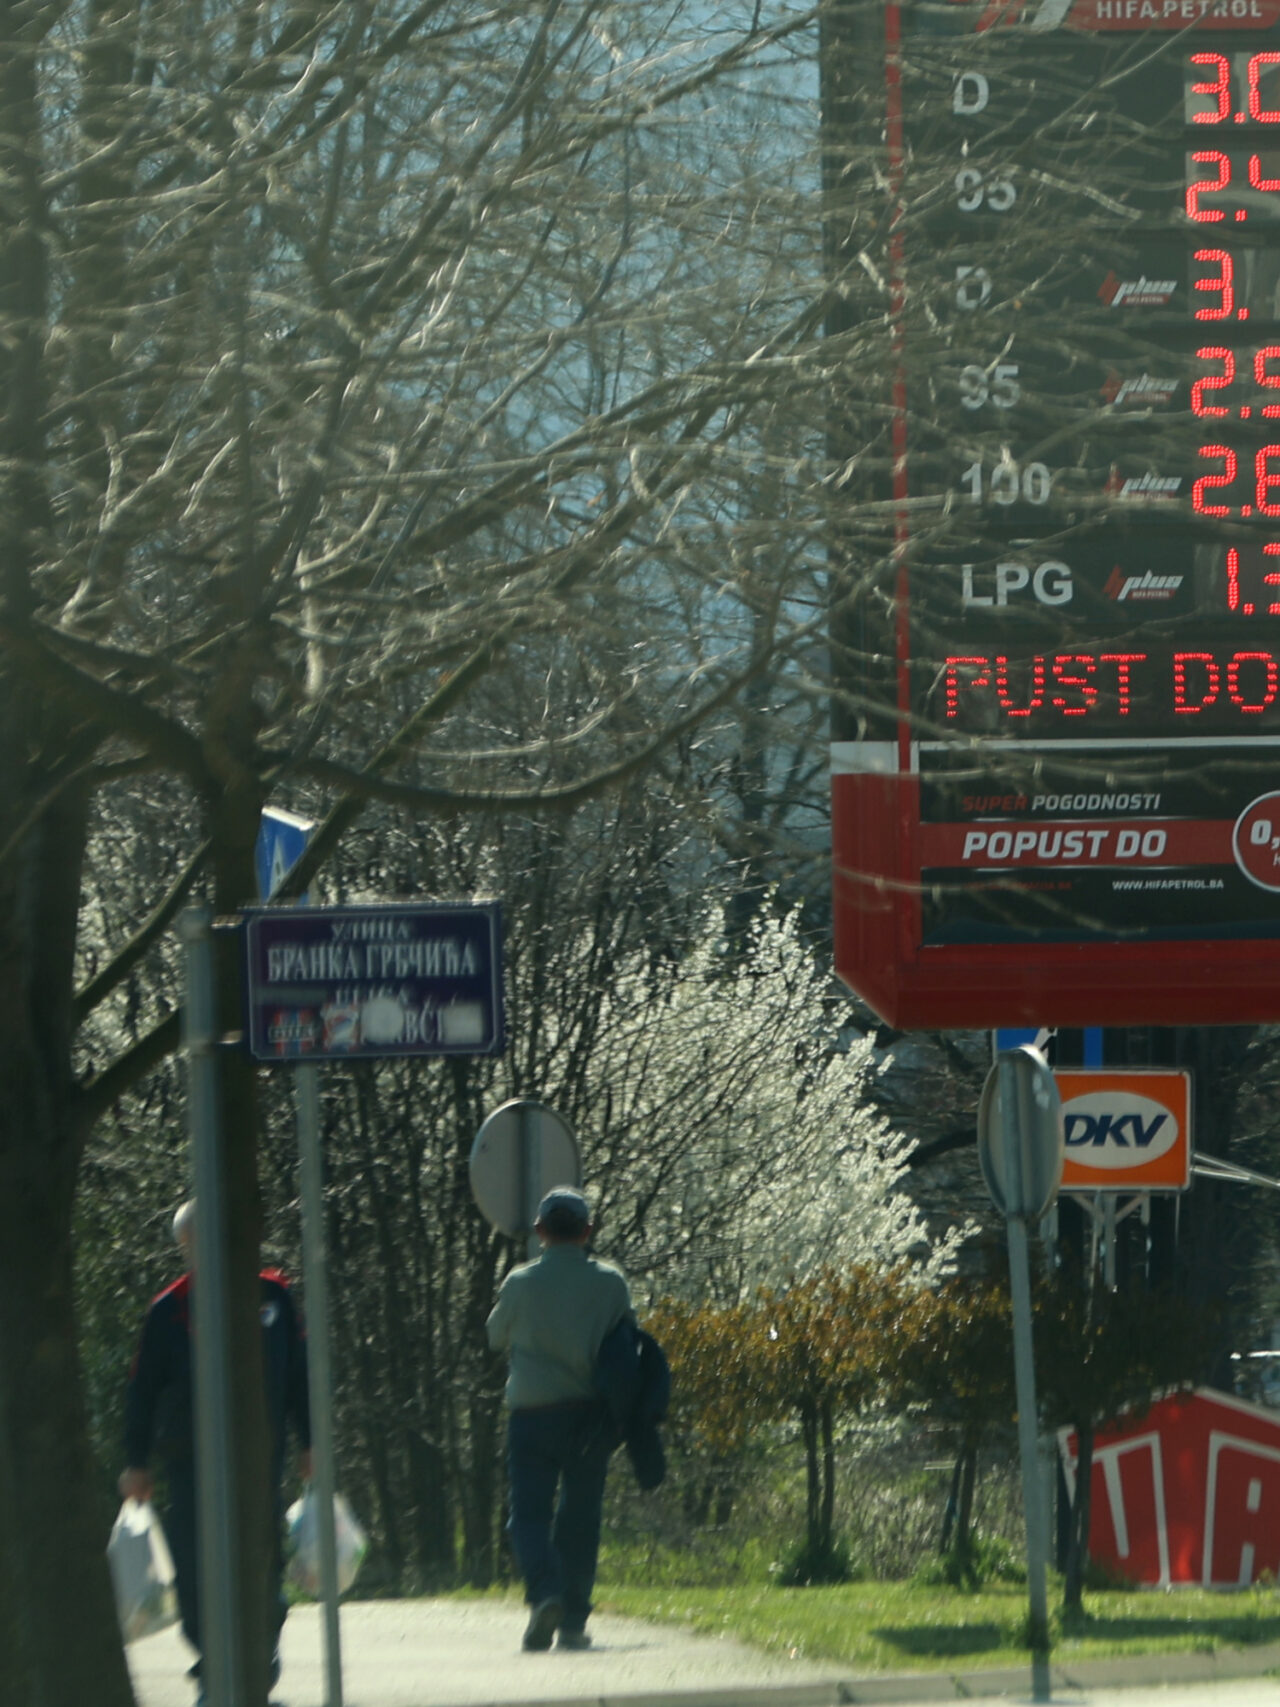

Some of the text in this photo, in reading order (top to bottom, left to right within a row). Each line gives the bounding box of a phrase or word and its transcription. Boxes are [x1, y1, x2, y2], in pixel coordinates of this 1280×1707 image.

[953, 72, 989, 115] D
[961, 462, 1051, 505] 100
[961, 561, 1073, 607] LPG
[1118, 570, 1184, 601] plus
[945, 654, 1147, 718] PUST
[1173, 652, 1279, 714] DO
[961, 793, 1161, 812] SUPER POGODNOSTI
[962, 828, 1168, 860] POPUST DO
[1112, 879, 1225, 892] WWW.HIFAPETROL.BA
[1065, 1113, 1169, 1148] DKV
